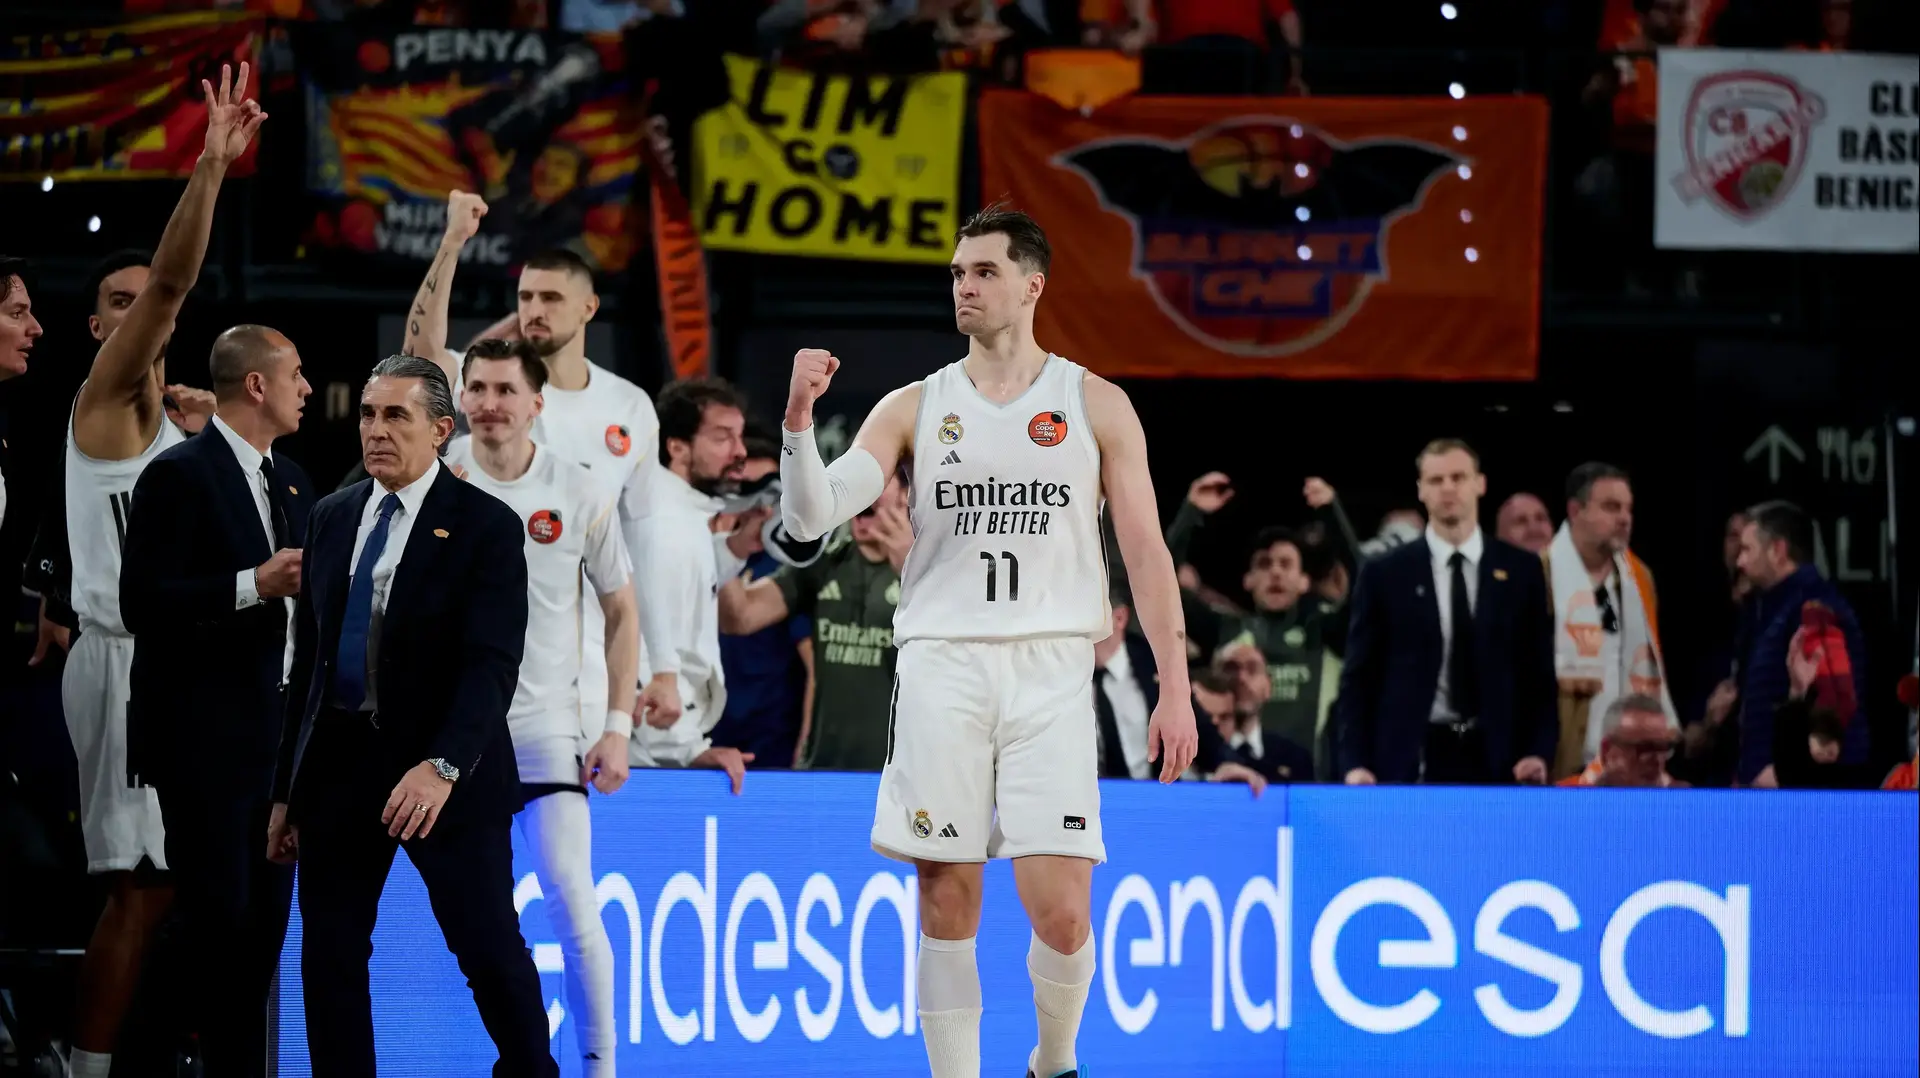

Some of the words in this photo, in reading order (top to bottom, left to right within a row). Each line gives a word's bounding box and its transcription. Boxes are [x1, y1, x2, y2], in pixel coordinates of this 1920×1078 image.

[395, 30, 546, 69] PENYA
[746, 66, 909, 137] LIM
[1815, 174, 1918, 211] BENIC
[703, 179, 946, 248] HOME
[935, 476, 1071, 510] Emirates
[954, 511, 982, 536] FLY
[986, 511, 1050, 536] BETTER
[980, 551, 1019, 602] 11
[818, 618, 893, 648] Emirates
[1065, 821, 1082, 829] acb
